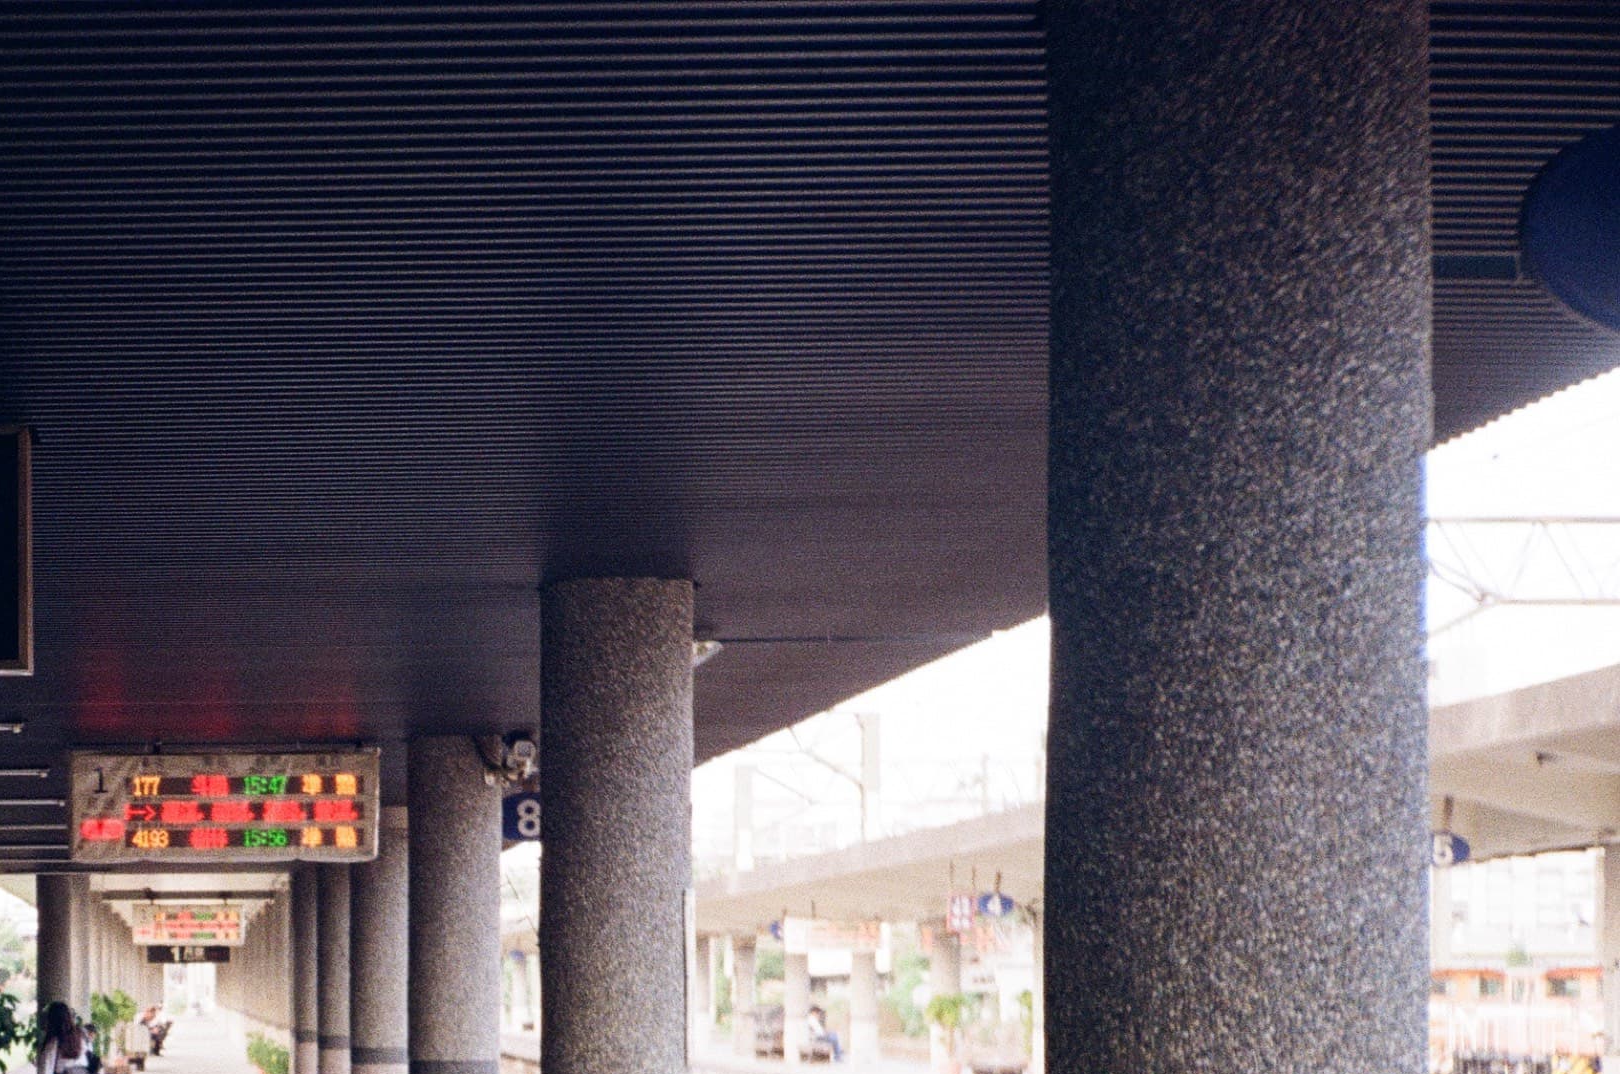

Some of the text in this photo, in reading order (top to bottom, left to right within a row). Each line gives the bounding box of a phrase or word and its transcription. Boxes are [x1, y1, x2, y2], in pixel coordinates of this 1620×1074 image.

[92, 767, 108, 793] 1
[132, 775, 160, 796] 177
[244, 775, 287, 795] 15:47
[516, 799, 541, 837] 8
[132, 829, 169, 848] 4193
[244, 828, 288, 848] 15:56
